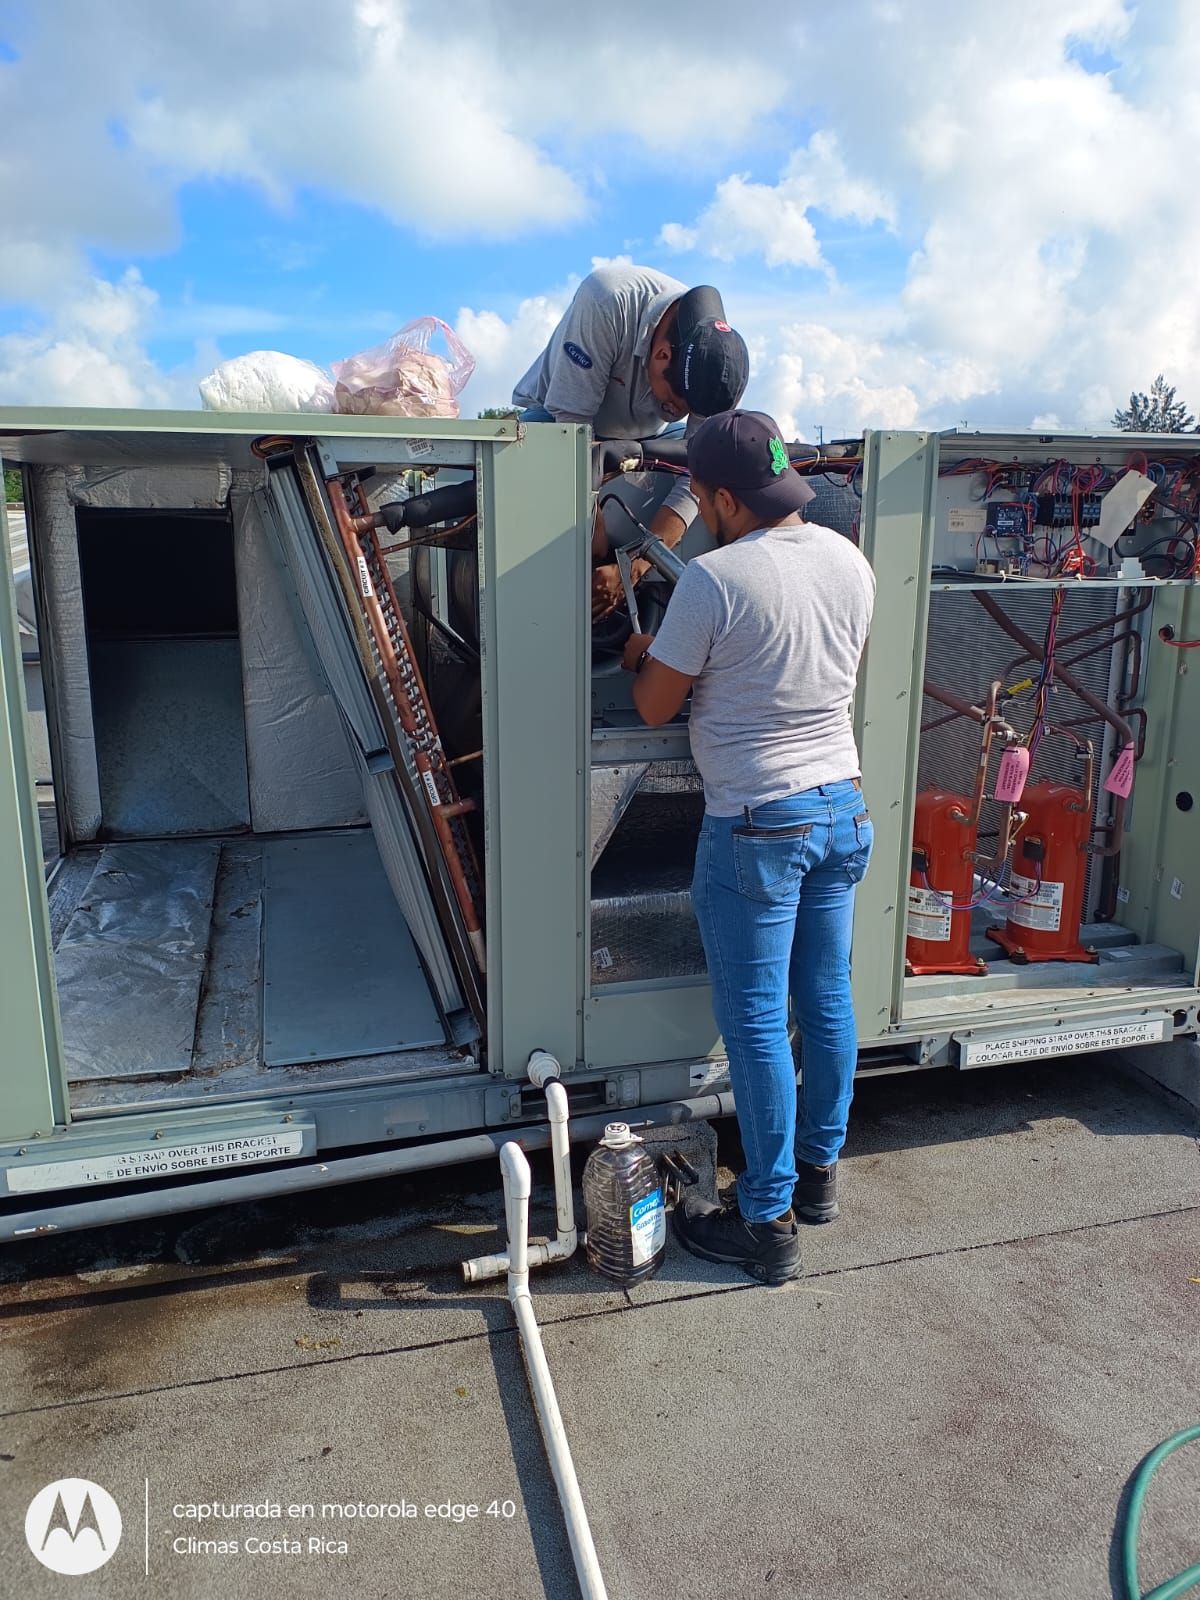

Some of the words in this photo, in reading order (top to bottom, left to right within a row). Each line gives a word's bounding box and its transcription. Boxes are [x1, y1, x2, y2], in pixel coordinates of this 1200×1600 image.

[360, 569, 370, 594] CIRCUIT
[985, 1041, 1010, 1051] PLACE
[1011, 1037, 1047, 1048] SHIPPING
[1048, 1033, 1073, 1043] STRAP
[1074, 1031, 1095, 1040] OVER
[1039, 1045, 1050, 1054] DE
[1074, 1039, 1100, 1050] SOBRE
[1101, 1037, 1120, 1046] ESTE
[168, 1147, 199, 1158] OVER
[200, 1143, 225, 1154] THIS
[117, 1168, 132, 1177] DE
[171, 1157, 209, 1170] SOBRE
[211, 1153, 238, 1164] ESTE
[241, 1146, 291, 1160] SOPORTE
